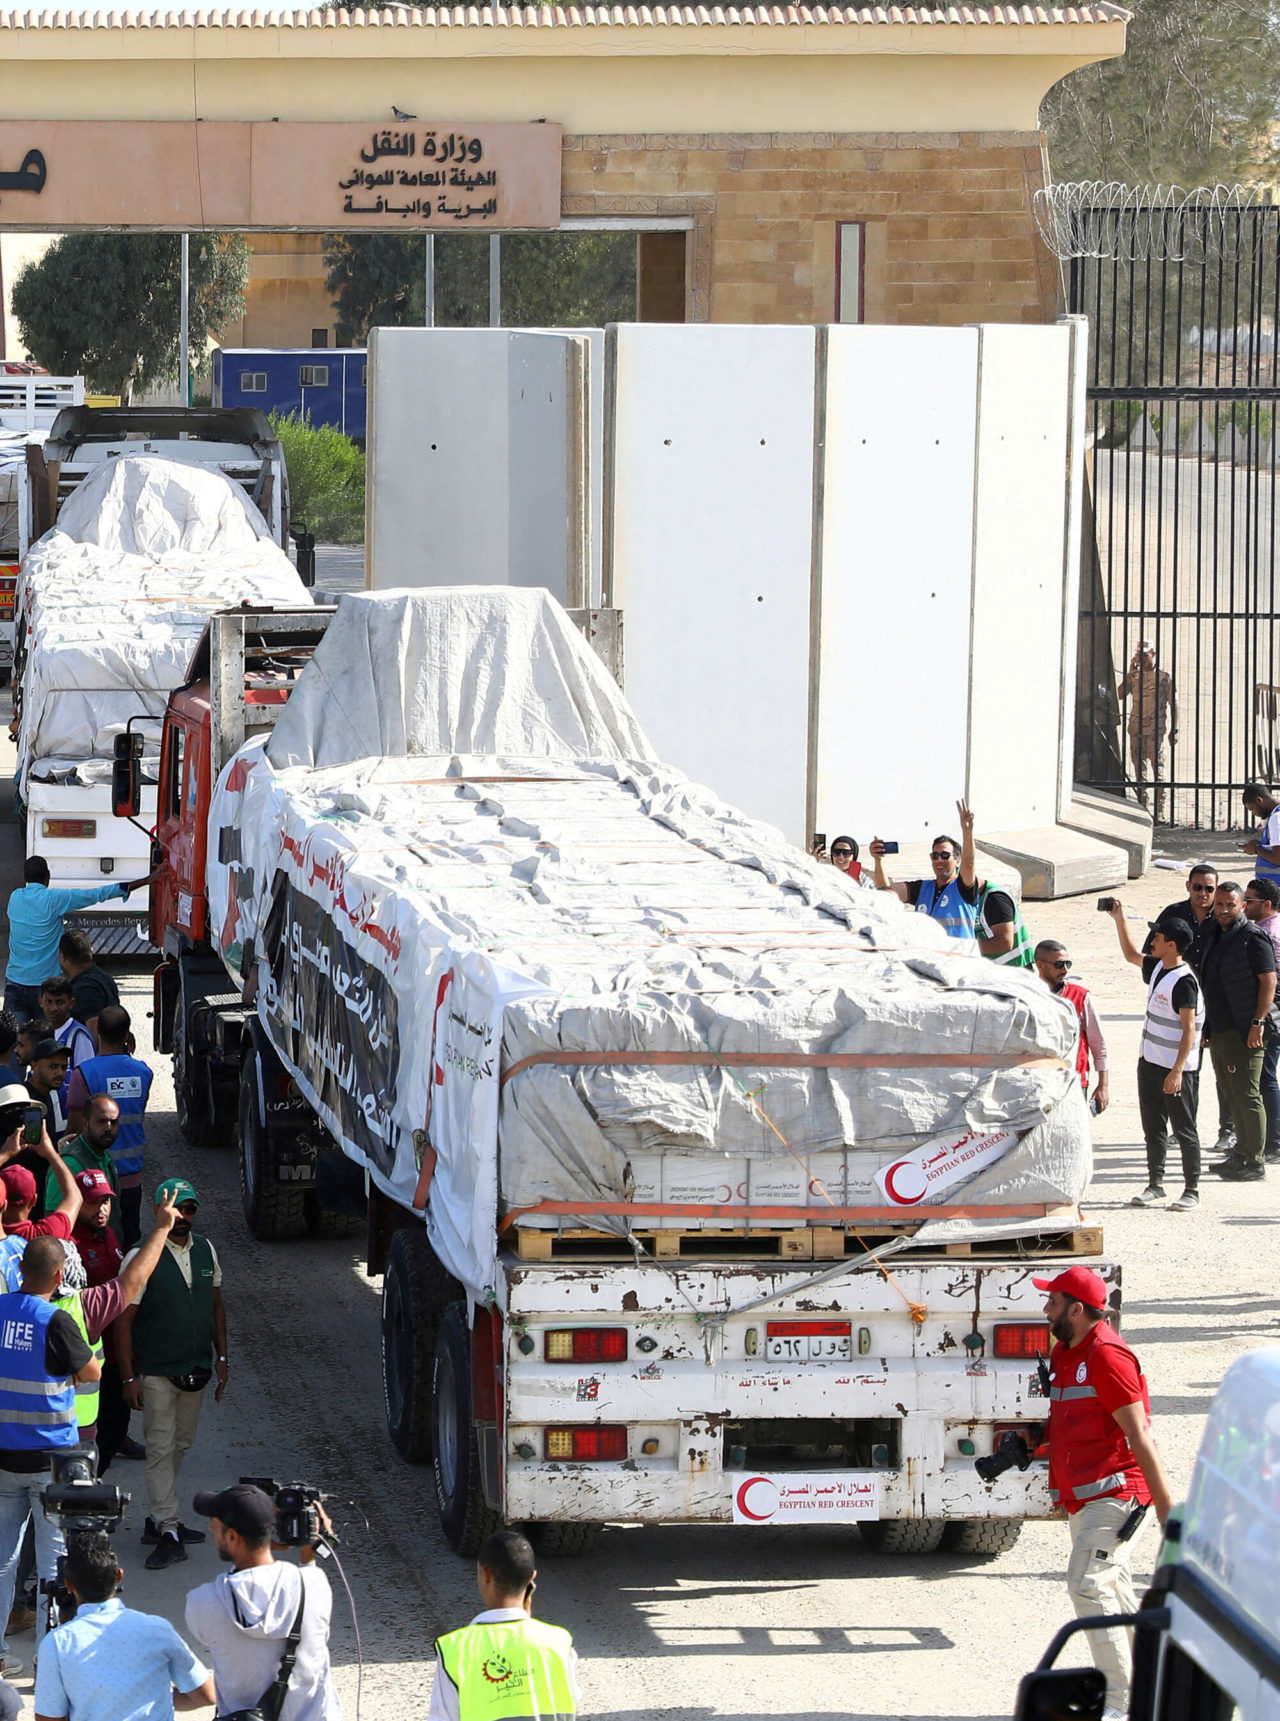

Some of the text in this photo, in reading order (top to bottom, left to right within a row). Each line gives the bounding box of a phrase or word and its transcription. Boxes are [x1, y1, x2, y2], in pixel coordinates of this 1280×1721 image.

[360, 131, 483, 163] وزارة النقل
[398, 168, 446, 187] العامة
[449, 168, 497, 191] الهيئة
[343, 194, 498, 219] البرية والجافة
[925, 1132, 1010, 1182] EGYPTIAN RED CRESCENT
[779, 1481, 875, 1497] الهلال الأحمر المصرى
[779, 1499, 875, 1510] EGYPTIAN RED CRESCENT
